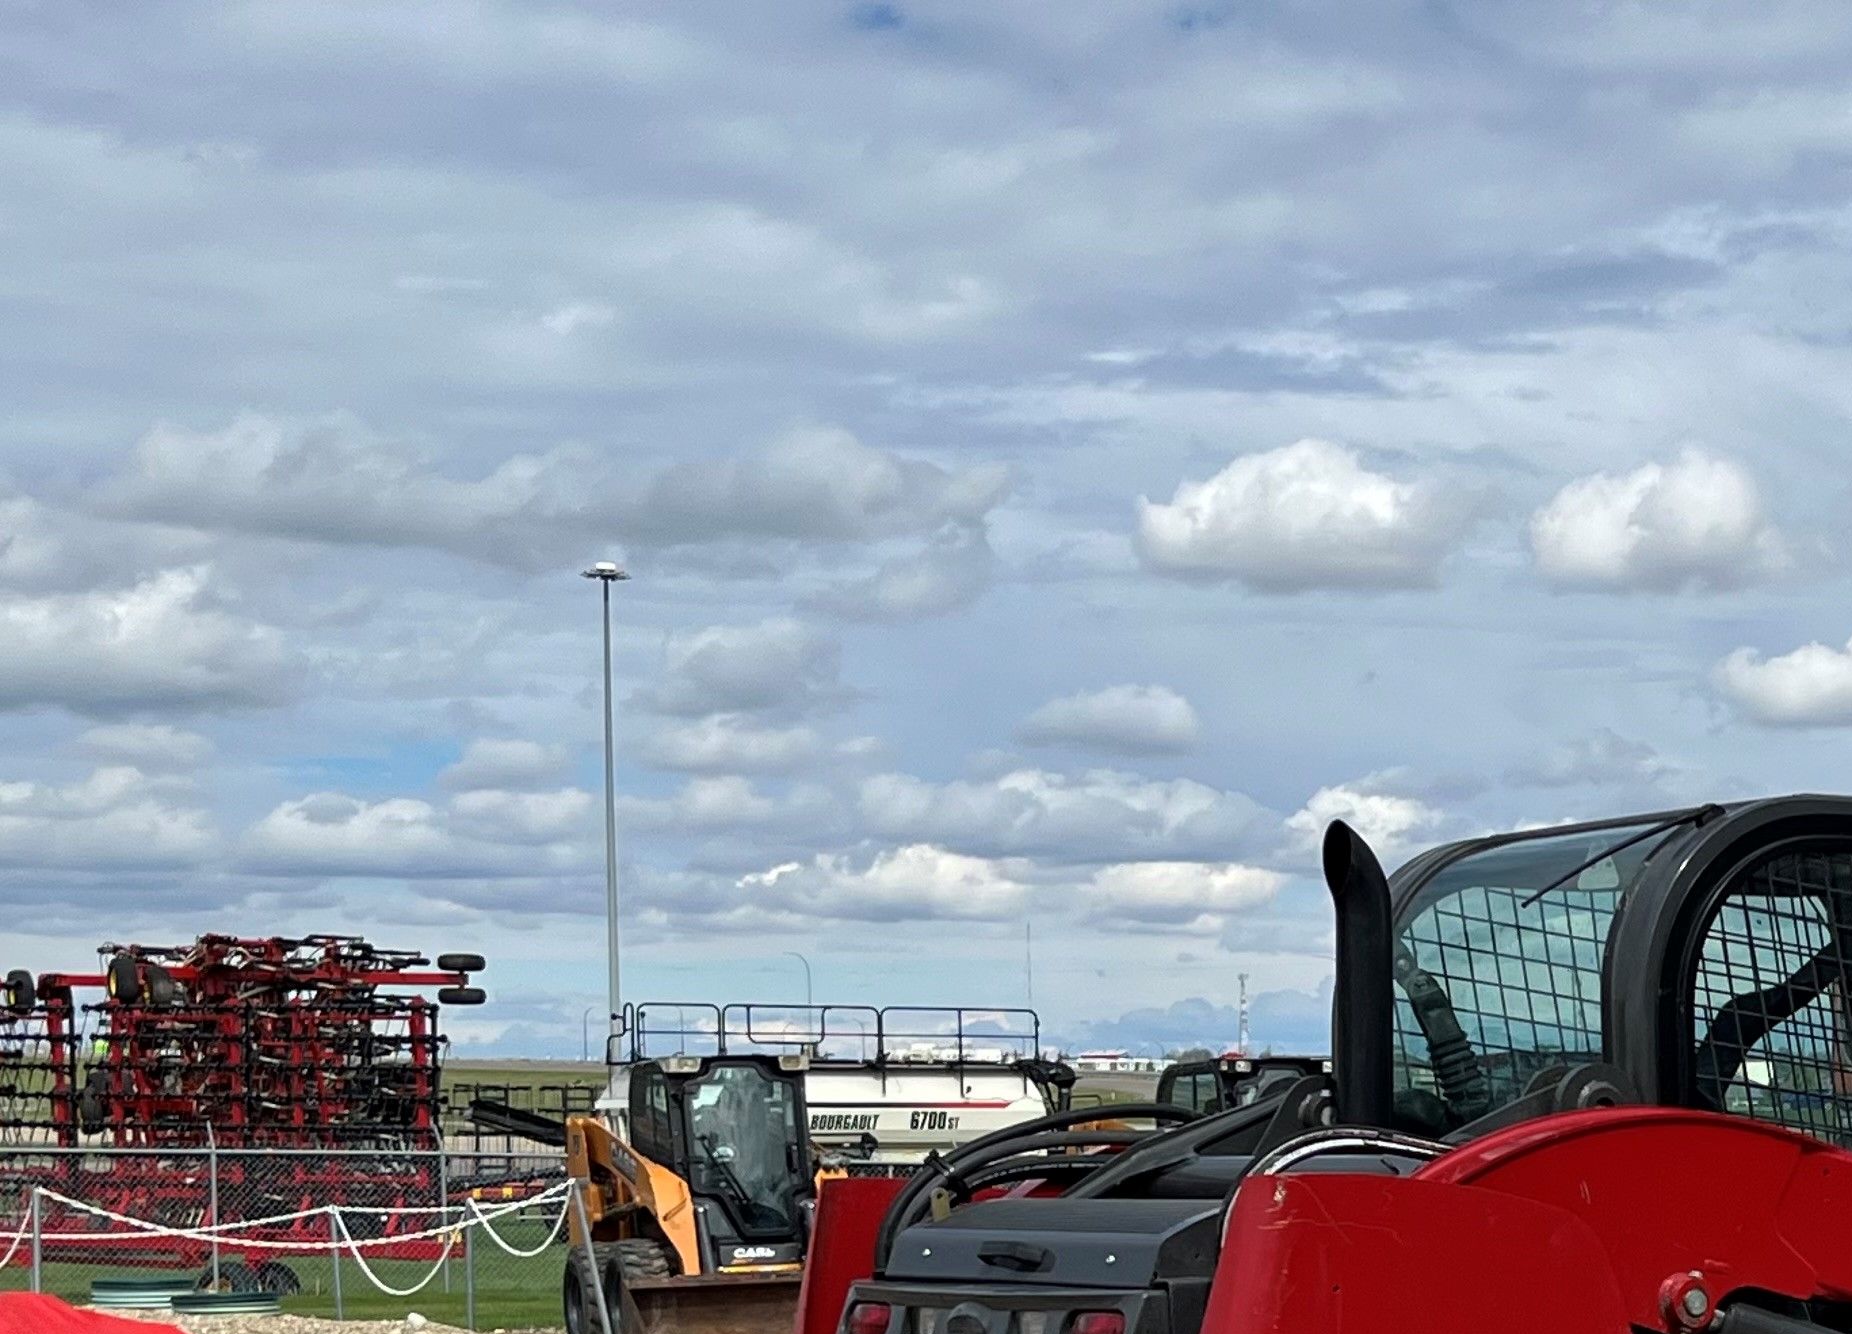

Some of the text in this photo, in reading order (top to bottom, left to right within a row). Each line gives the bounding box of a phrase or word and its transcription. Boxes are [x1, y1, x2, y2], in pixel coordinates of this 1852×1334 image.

[810, 1111, 960, 1131] BOURGAULT 6700 ST
